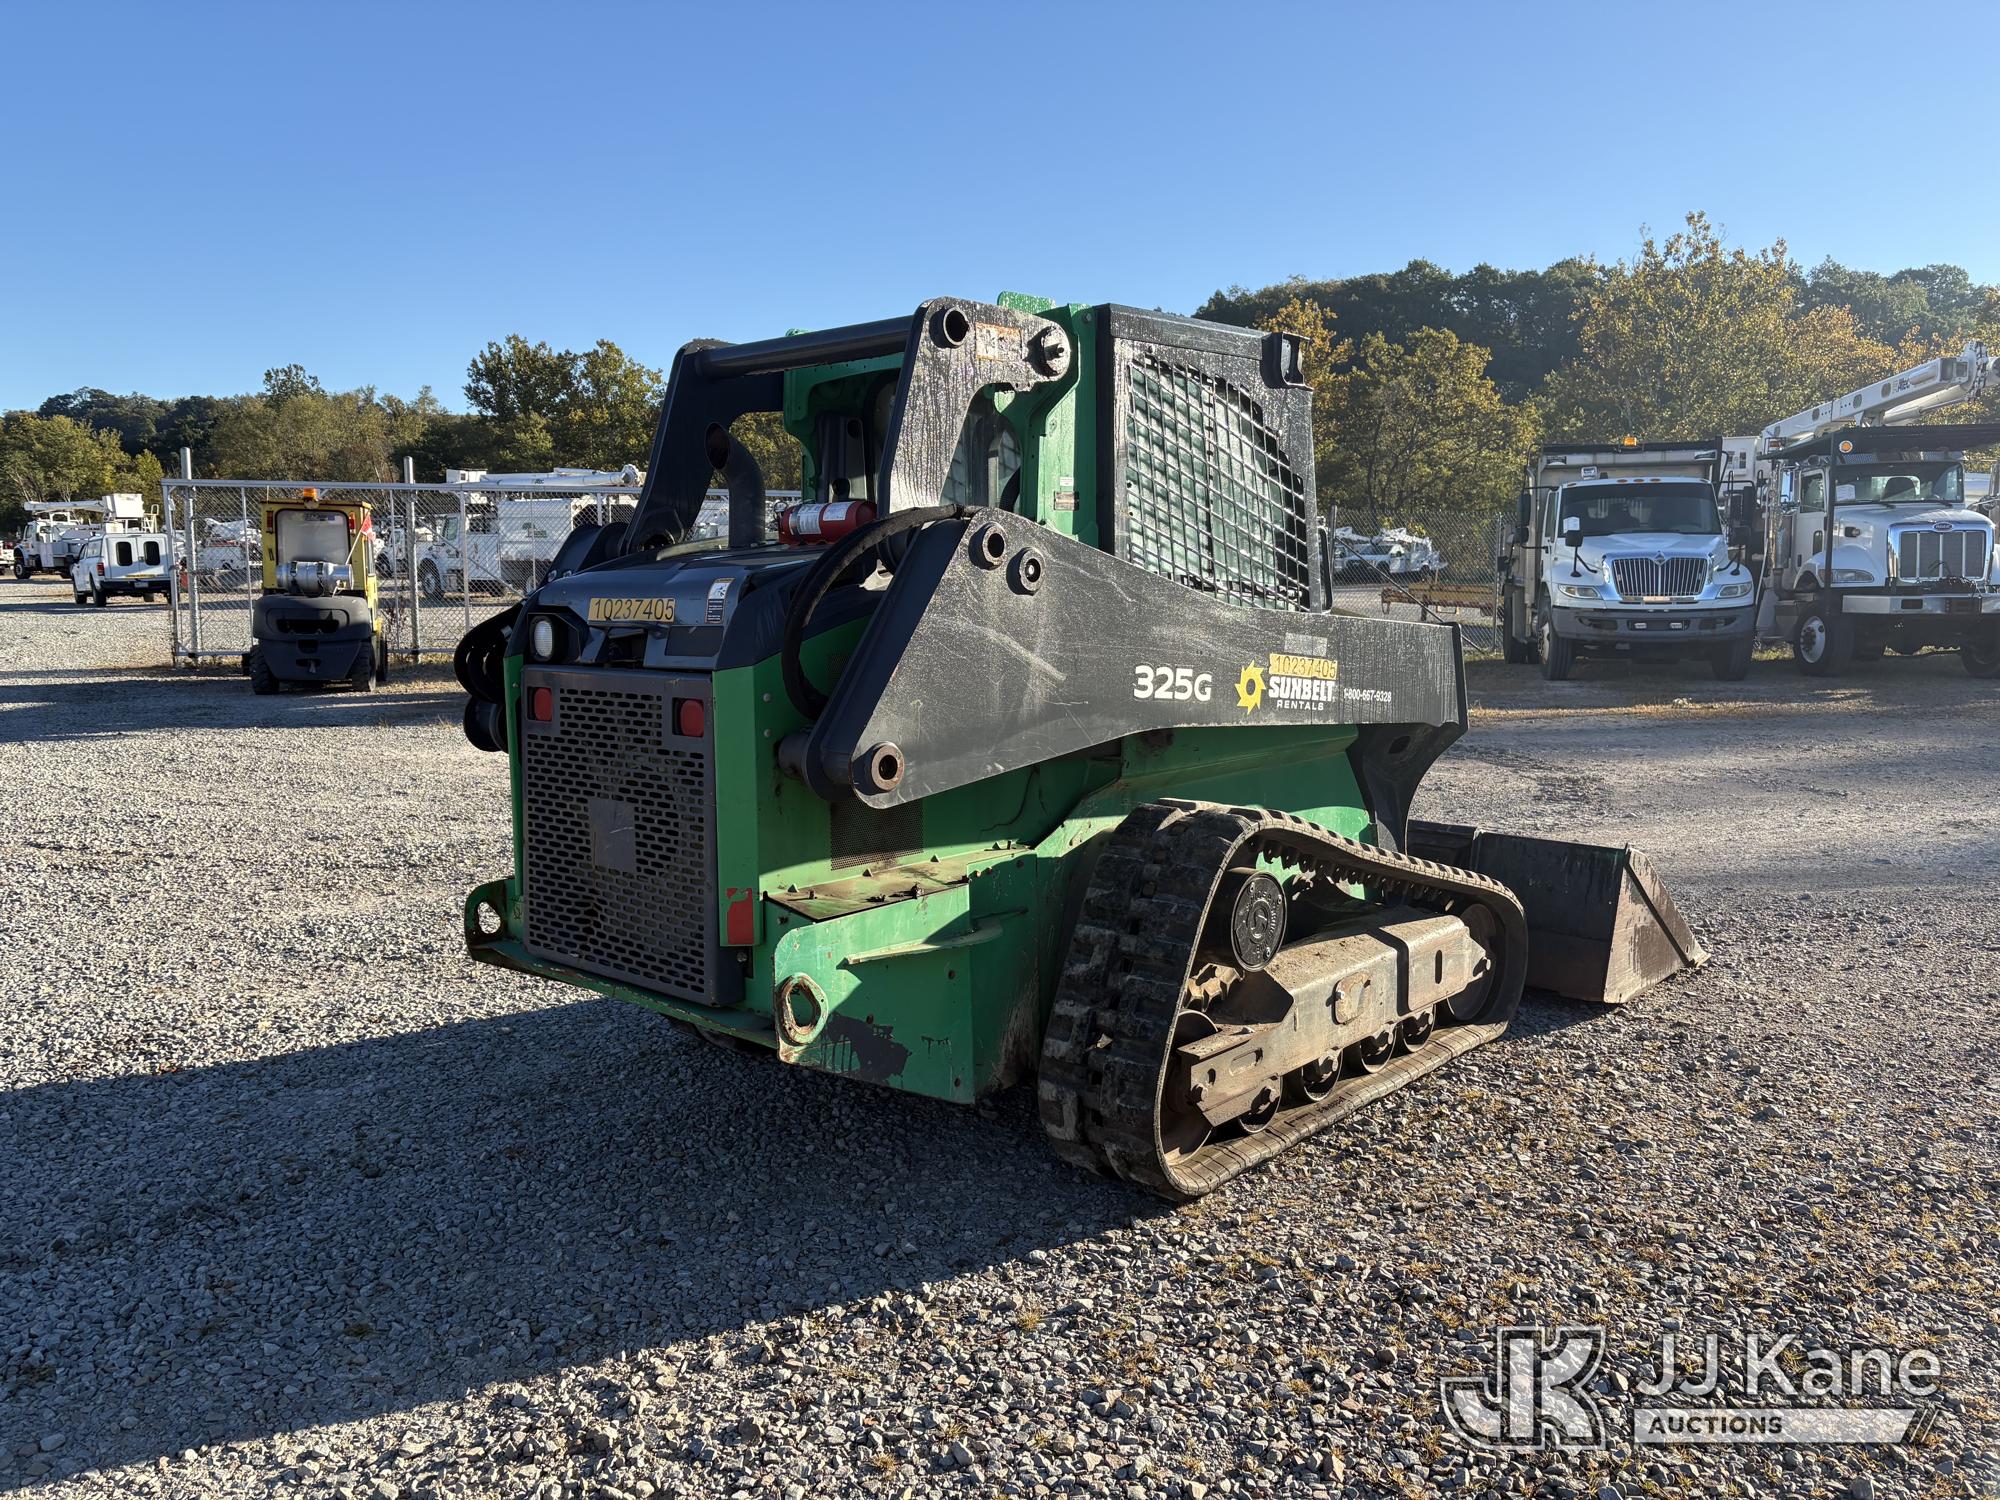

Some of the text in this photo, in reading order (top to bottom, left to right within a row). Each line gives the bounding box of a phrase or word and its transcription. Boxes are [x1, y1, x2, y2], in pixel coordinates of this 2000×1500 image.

[1276, 655, 1336, 679] 10237405
[1133, 664, 1213, 700] 325G
[1268, 676, 1335, 702] SUNBELT
[1276, 699, 1325, 711] RENTALS
